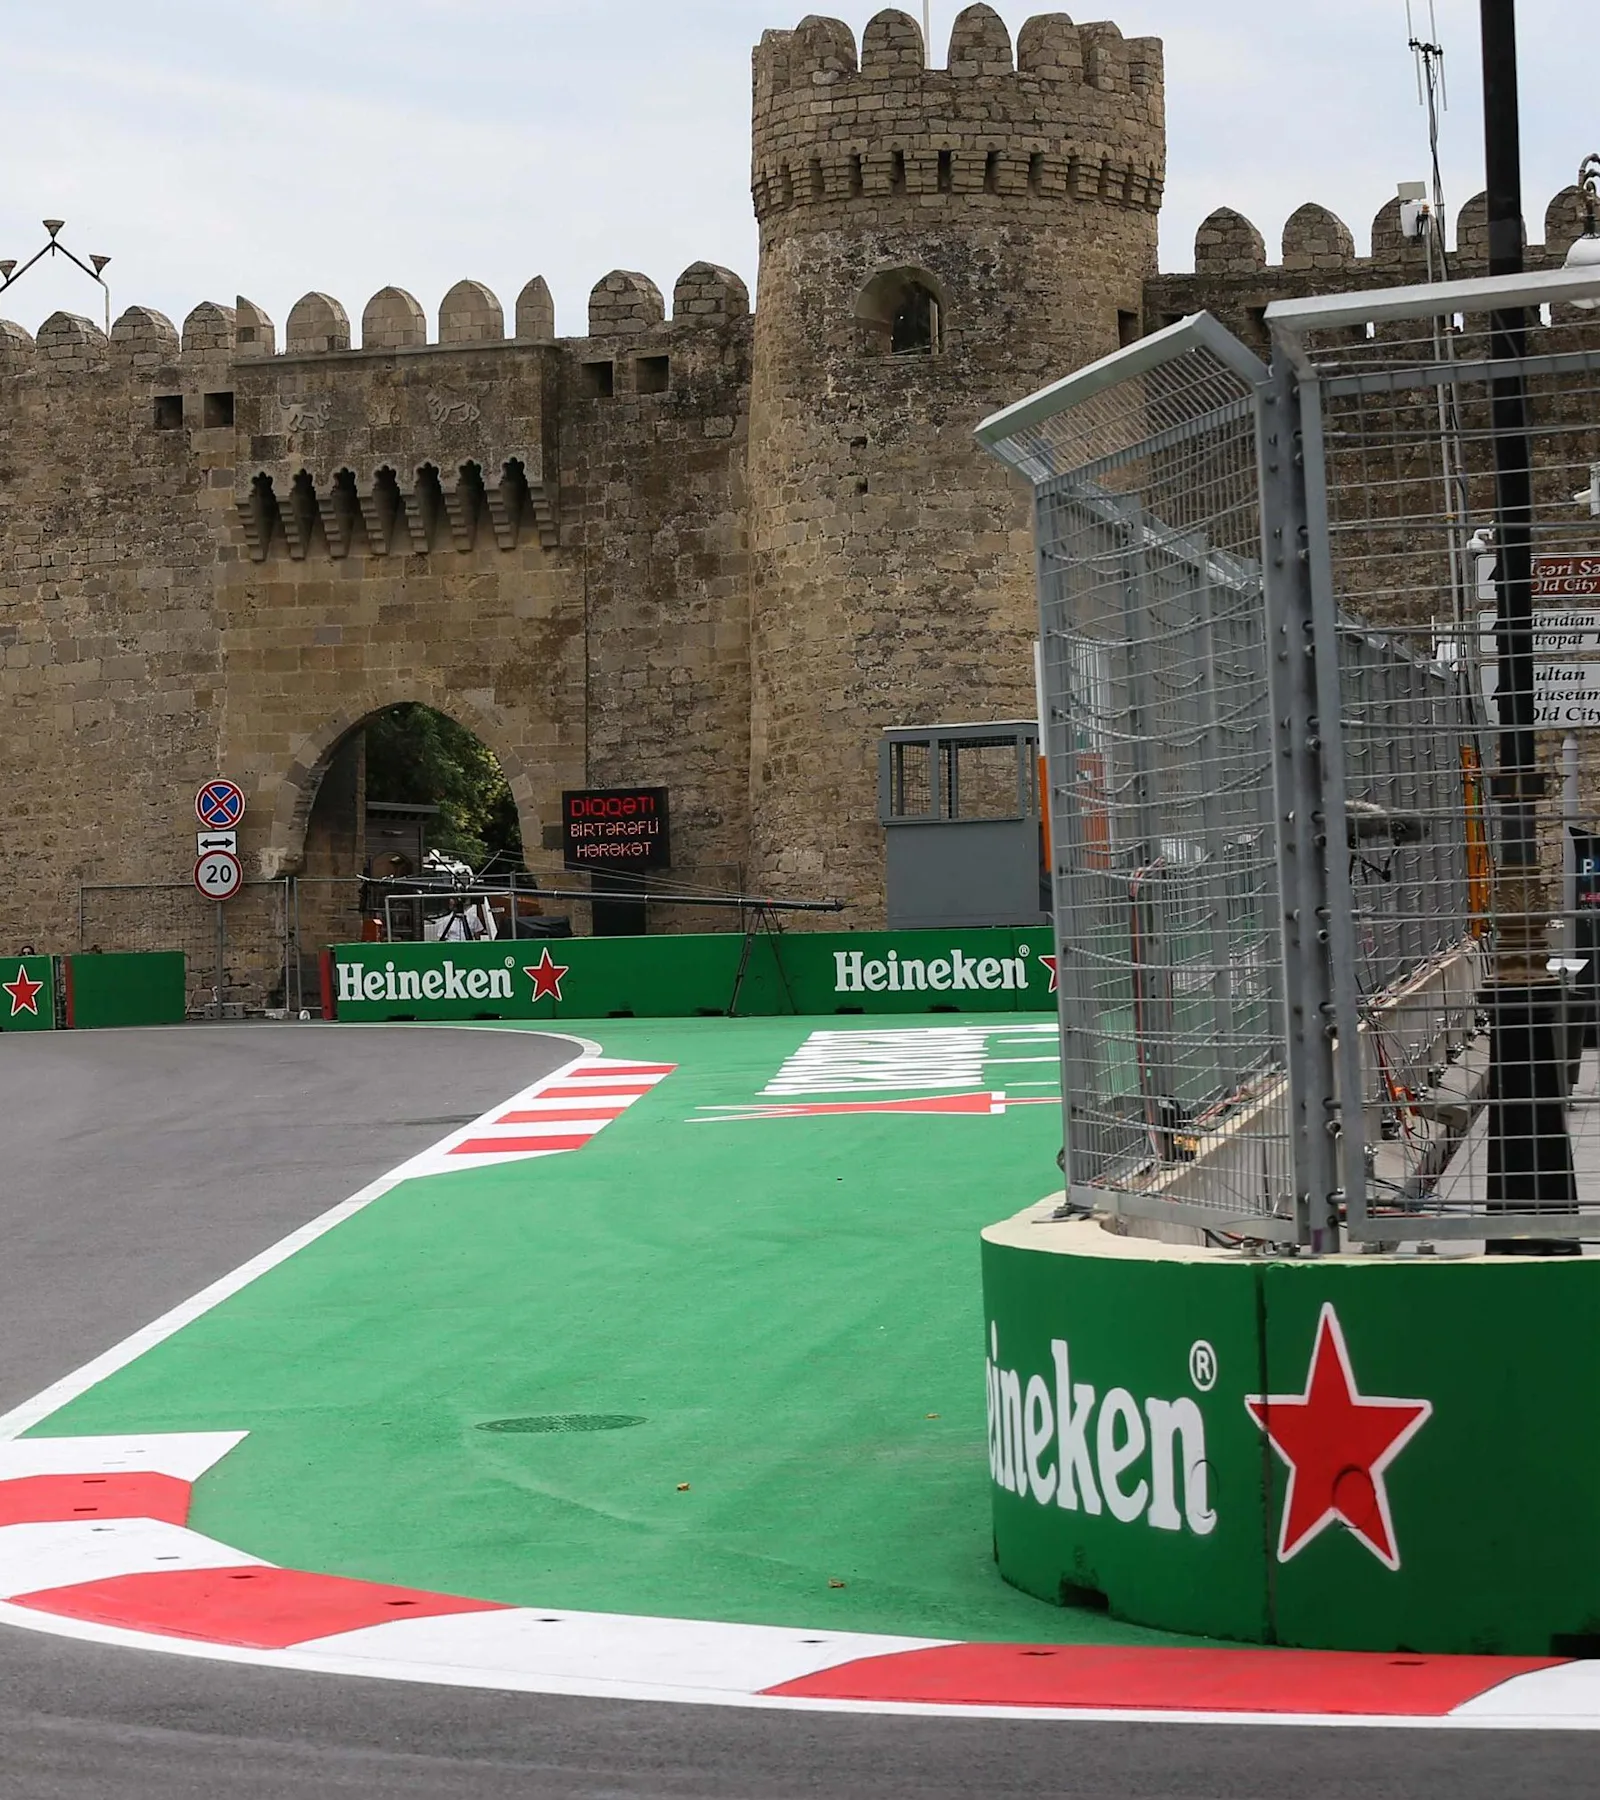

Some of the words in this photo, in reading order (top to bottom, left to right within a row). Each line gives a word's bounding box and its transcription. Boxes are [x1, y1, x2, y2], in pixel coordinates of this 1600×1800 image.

[1563, 578, 1598, 594] City
[1535, 633, 1584, 649] tropat
[1536, 666, 1586, 681] ultan
[206, 865, 231, 883] 20
